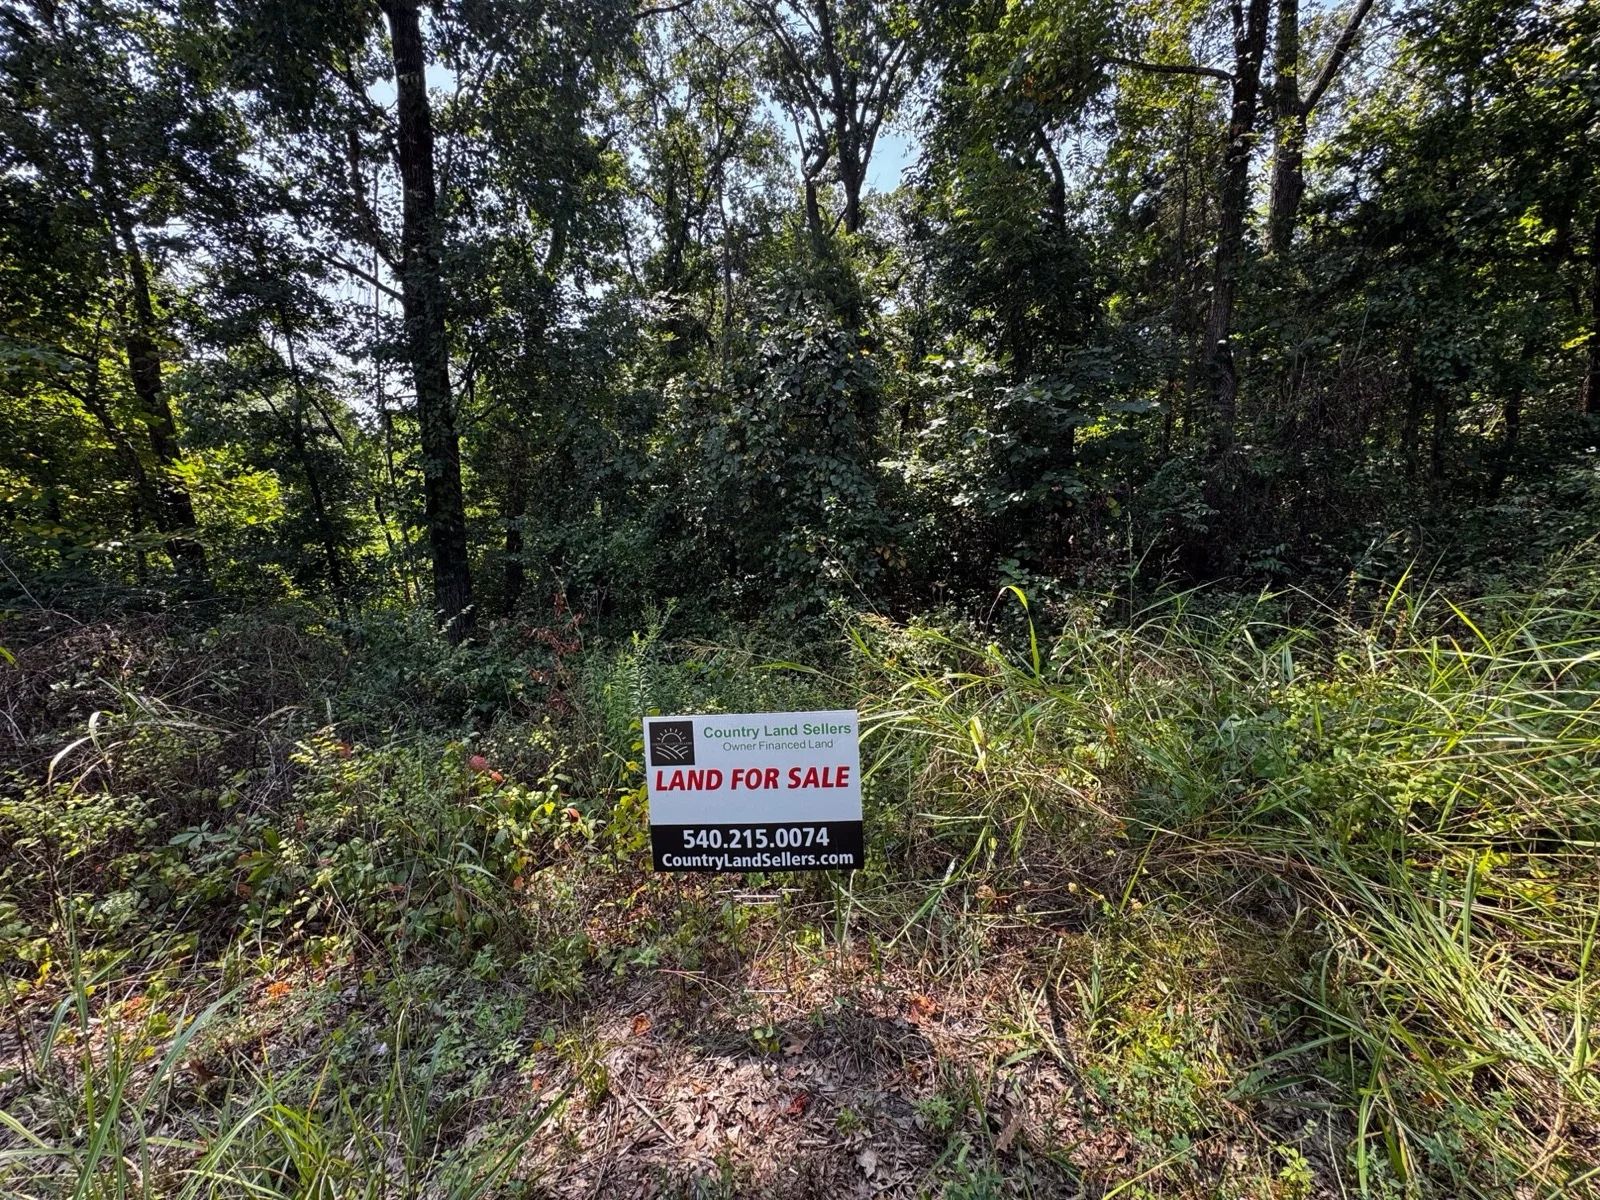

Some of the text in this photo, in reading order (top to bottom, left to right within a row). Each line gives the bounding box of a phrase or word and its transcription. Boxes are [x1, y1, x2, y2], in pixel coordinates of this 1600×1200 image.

[704, 723, 852, 740] Country Land Sellers
[723, 739, 833, 751] Owner Financed Land
[656, 766, 850, 791] LAND FOR SALE
[683, 827, 829, 849] 540.215.0074
[662, 852, 853, 870] CountryLandSellers.com
